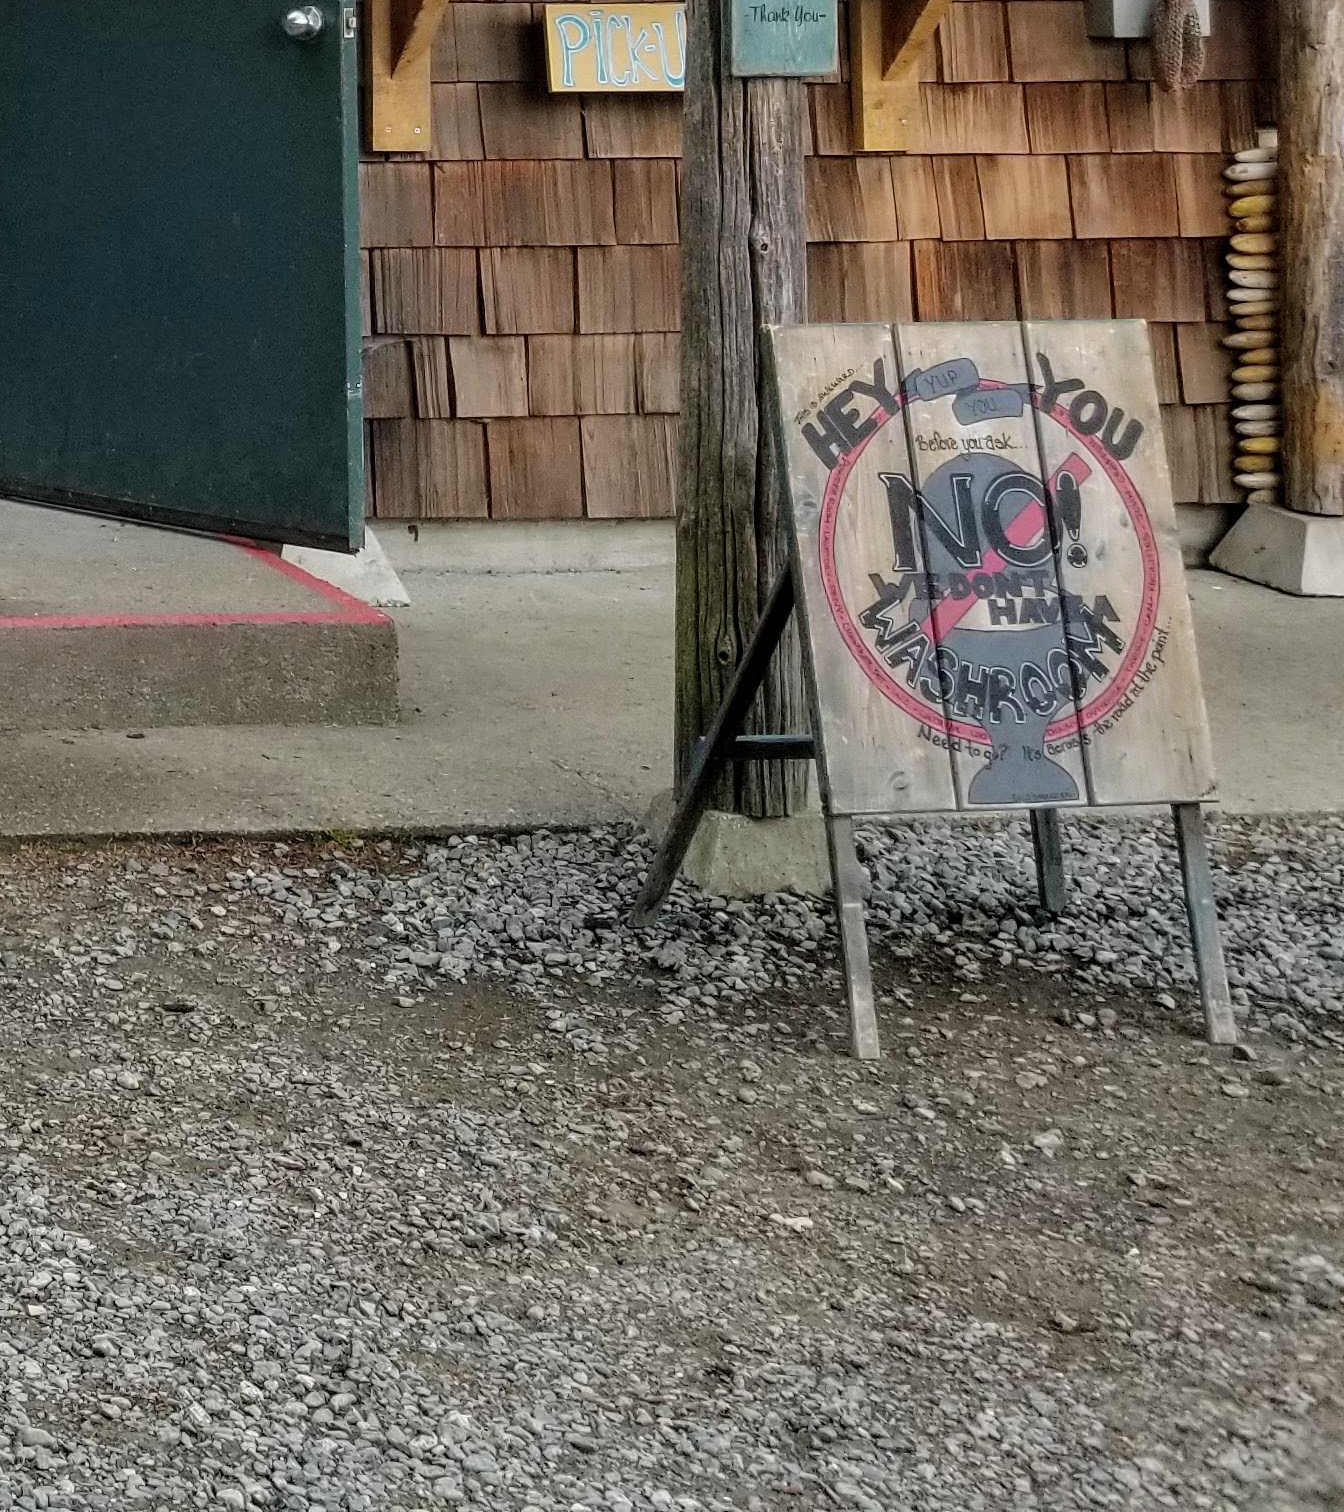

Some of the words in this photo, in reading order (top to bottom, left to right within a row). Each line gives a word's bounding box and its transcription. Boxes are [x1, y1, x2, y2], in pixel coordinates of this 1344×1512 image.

[802, 358, 900, 470] HEY
[1036, 352, 1144, 461] YOU
[924, 370, 958, 393] YUP
[965, 398, 998, 416] YOU
[916, 431, 958, 451] Before
[962, 439, 982, 461] you
[879, 470, 1088, 572] NO!
[858, 599, 1125, 724] WASHROOM
[917, 725, 961, 752] Need
[964, 740, 980, 757] to
[1093, 720, 1113, 735] the
[1113, 696, 1134, 722] road
